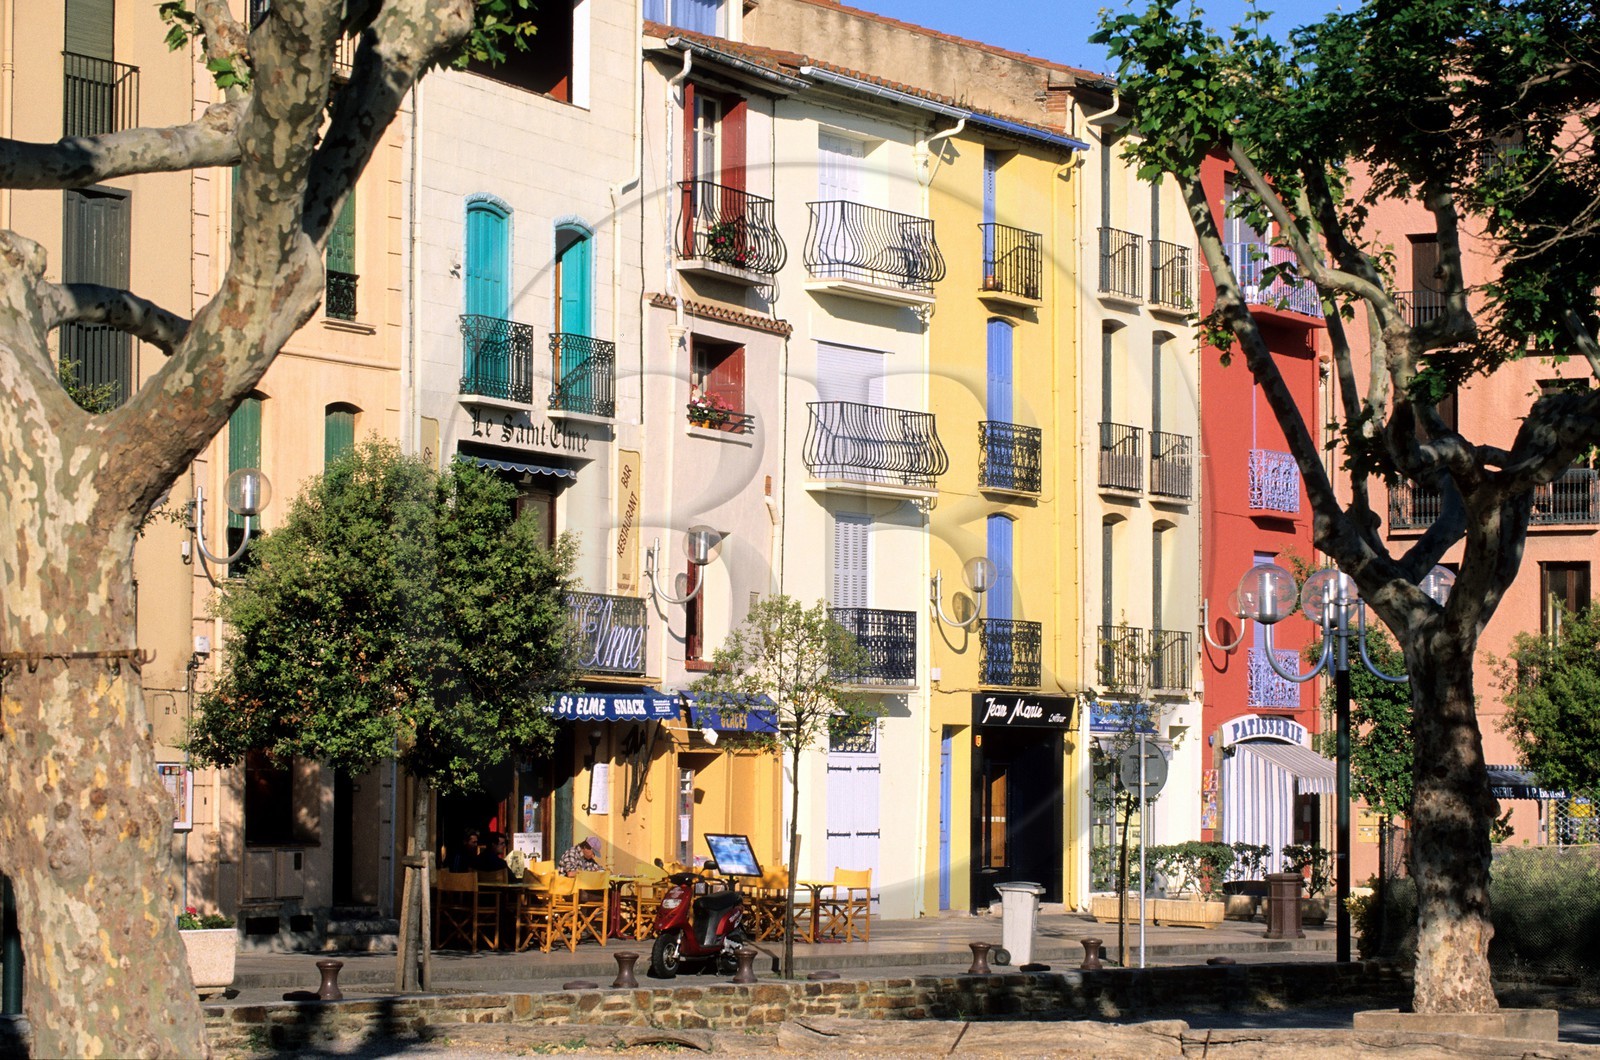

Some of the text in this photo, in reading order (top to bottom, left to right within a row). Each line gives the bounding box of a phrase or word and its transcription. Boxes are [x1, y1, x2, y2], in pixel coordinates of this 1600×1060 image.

[470, 406, 493, 438] Le
[620, 464, 632, 489] BAR
[617, 490, 638, 558] RESTAURANT
[576, 697, 606, 717] ELME
[614, 698, 647, 716] SNACK
[982, 697, 1043, 724] Jean Marie
[1232, 718, 1303, 744] PATISSERIE
